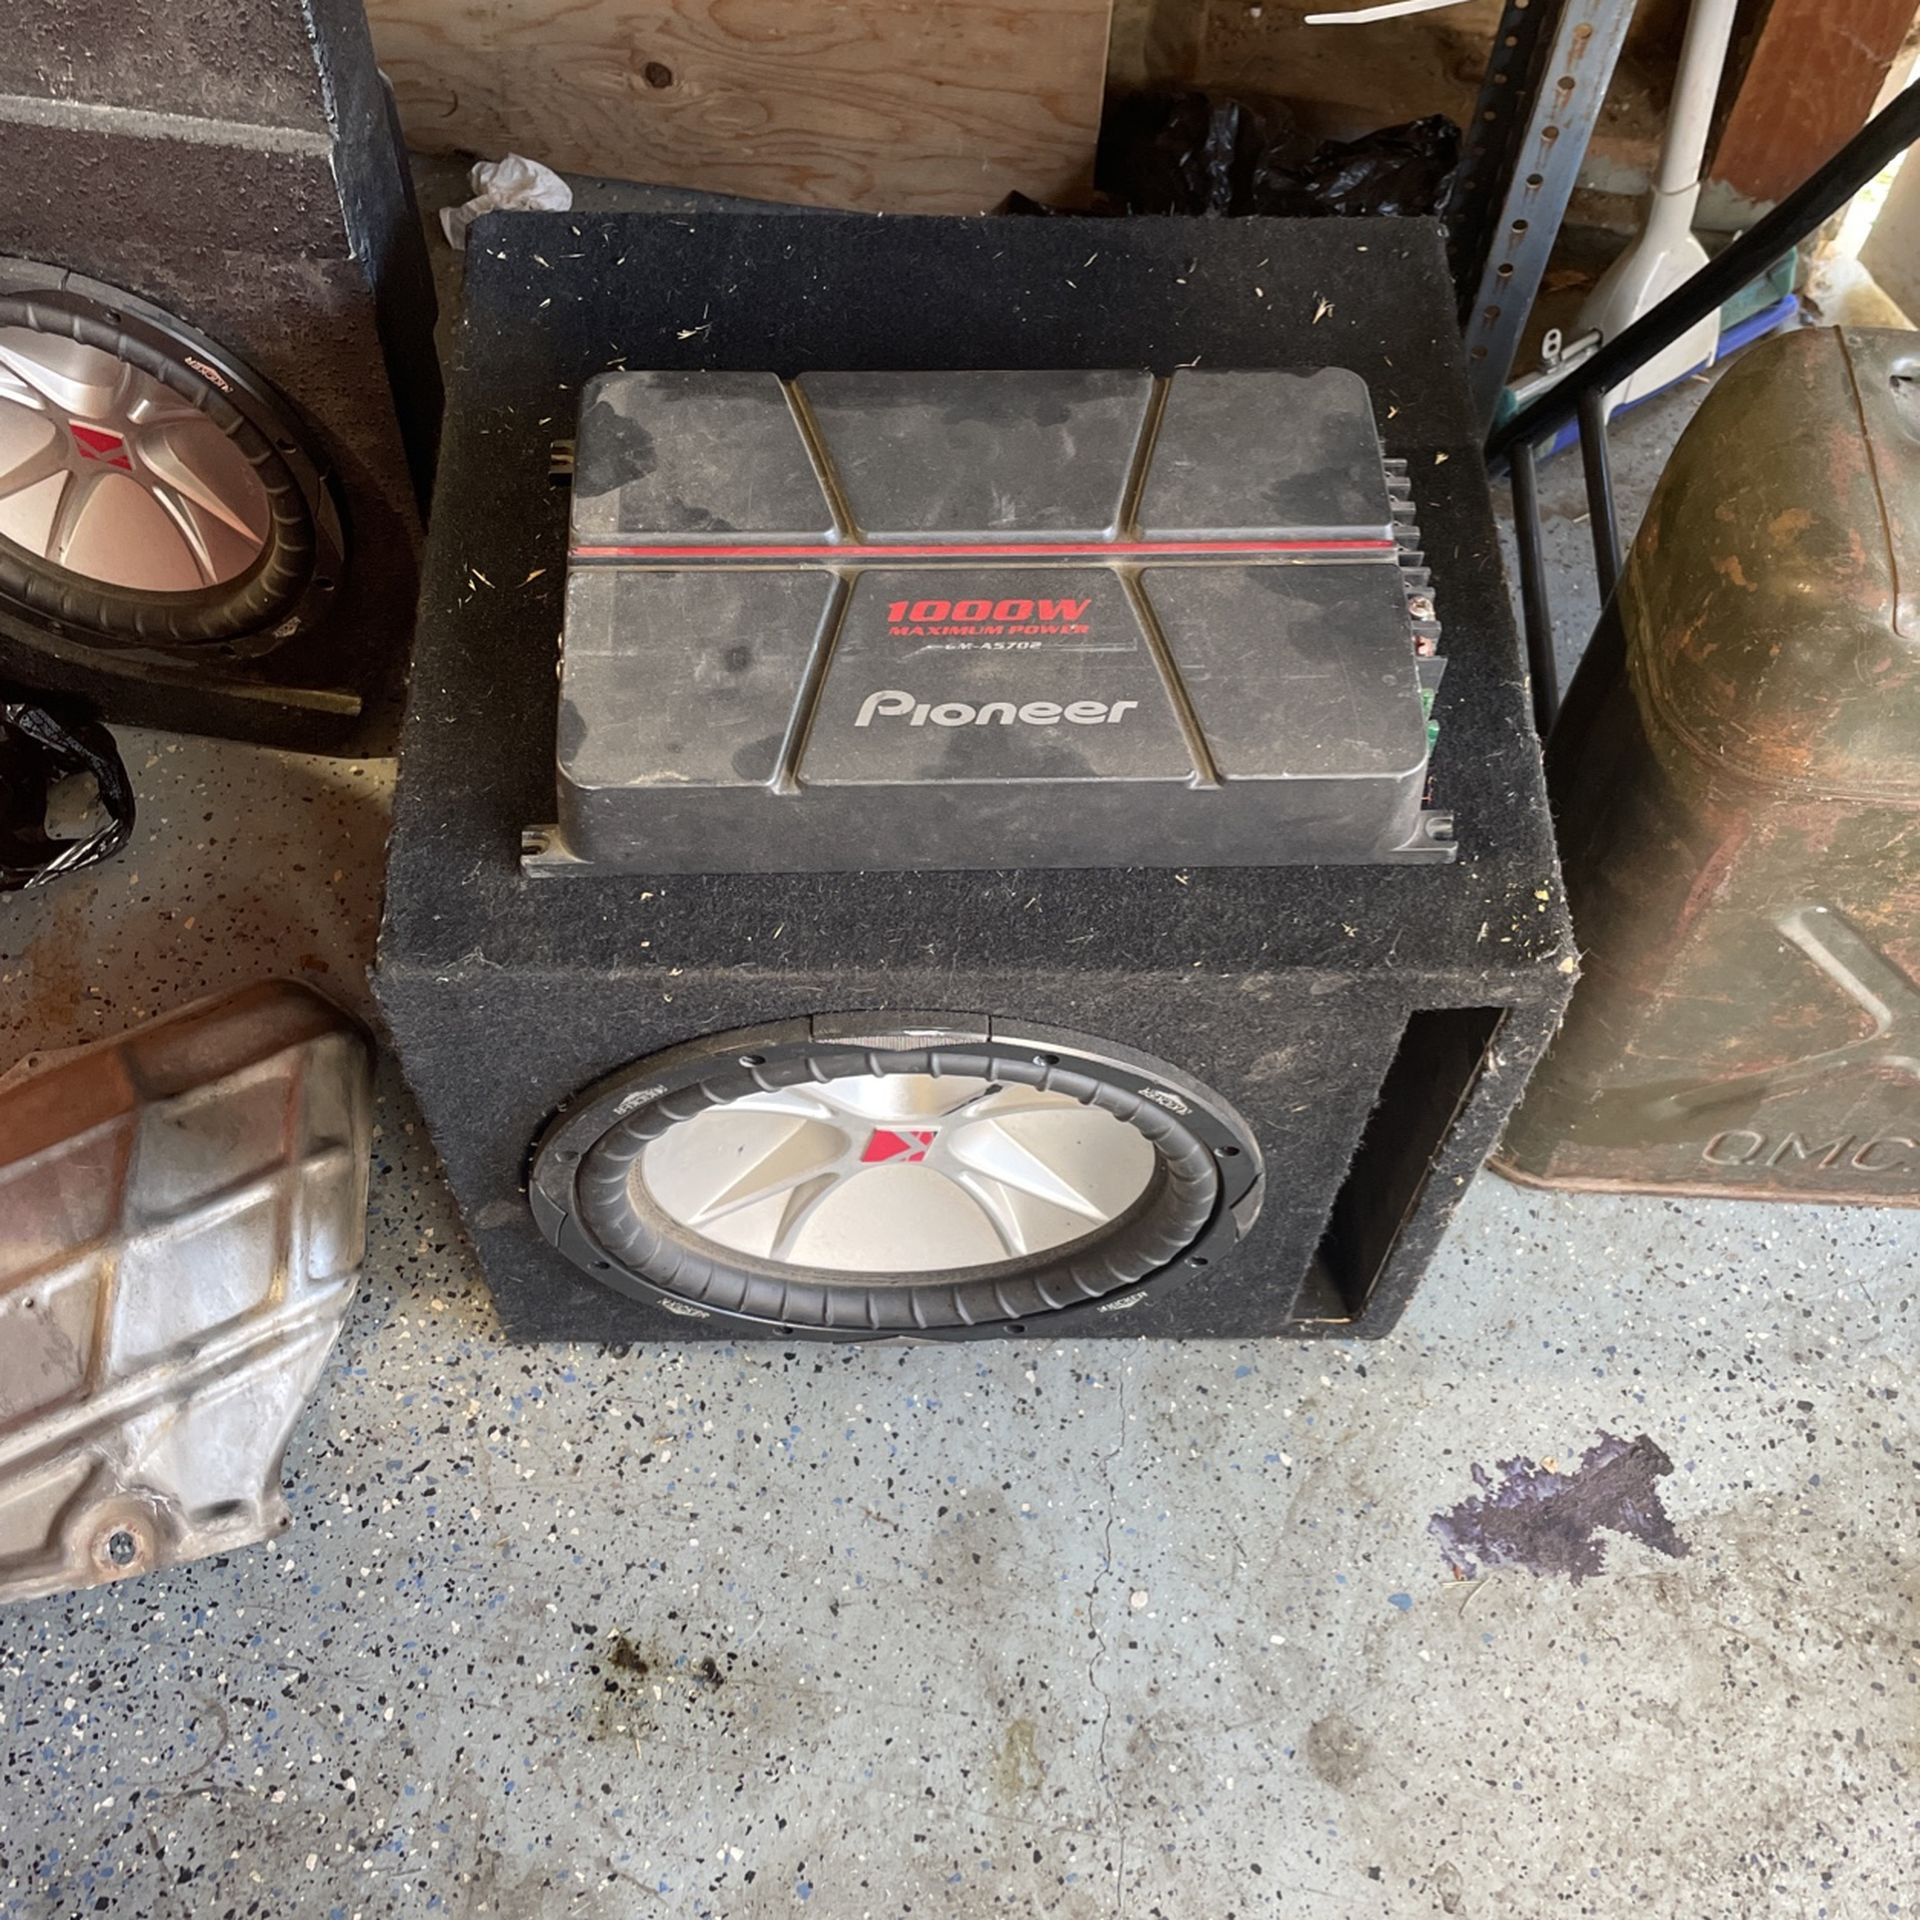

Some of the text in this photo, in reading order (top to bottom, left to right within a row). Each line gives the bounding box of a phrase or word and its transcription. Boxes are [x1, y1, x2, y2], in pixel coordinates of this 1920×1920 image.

[887, 598, 1092, 622] 1000W
[888, 624, 1090, 637] MAXIMUM POWER
[854, 689, 1139, 727] Pioneer
